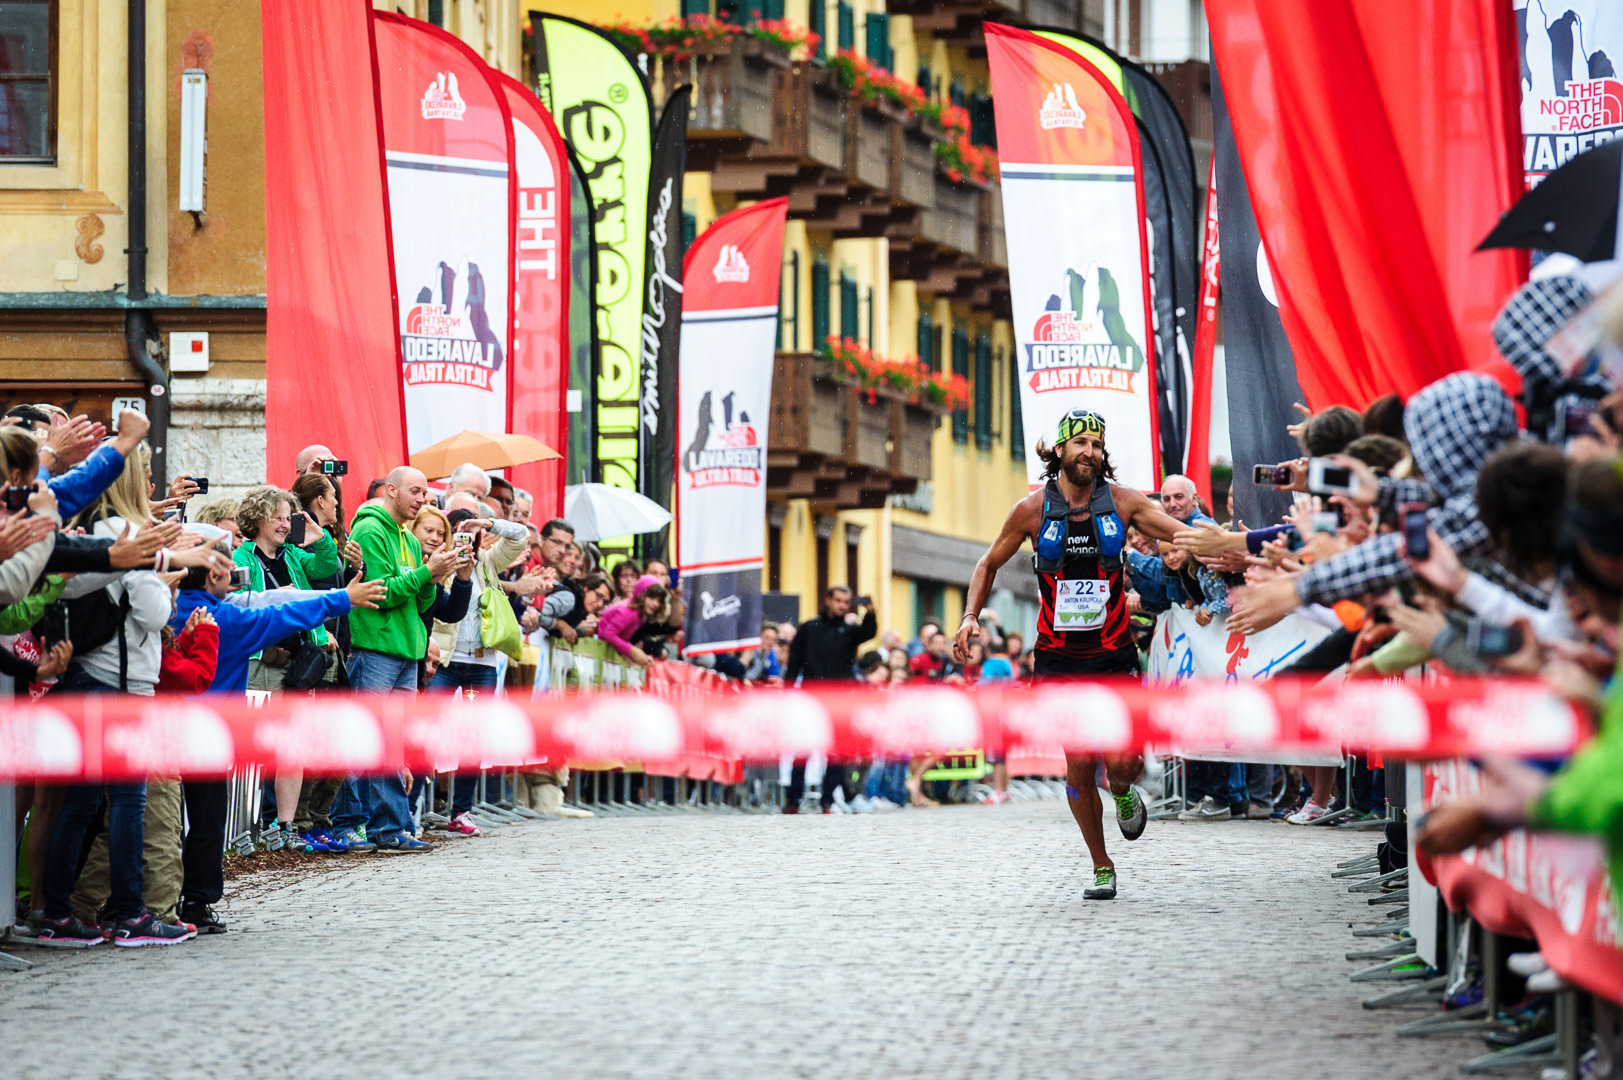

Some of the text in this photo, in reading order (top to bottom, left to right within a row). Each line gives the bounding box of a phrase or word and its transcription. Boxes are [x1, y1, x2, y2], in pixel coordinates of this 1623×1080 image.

[1568, 81, 1603, 98] THE
[1540, 96, 1603, 115] NORTH
[1559, 112, 1602, 131] FACE
[1067, 535, 1089, 545] new
[1075, 580, 1094, 595] 22
